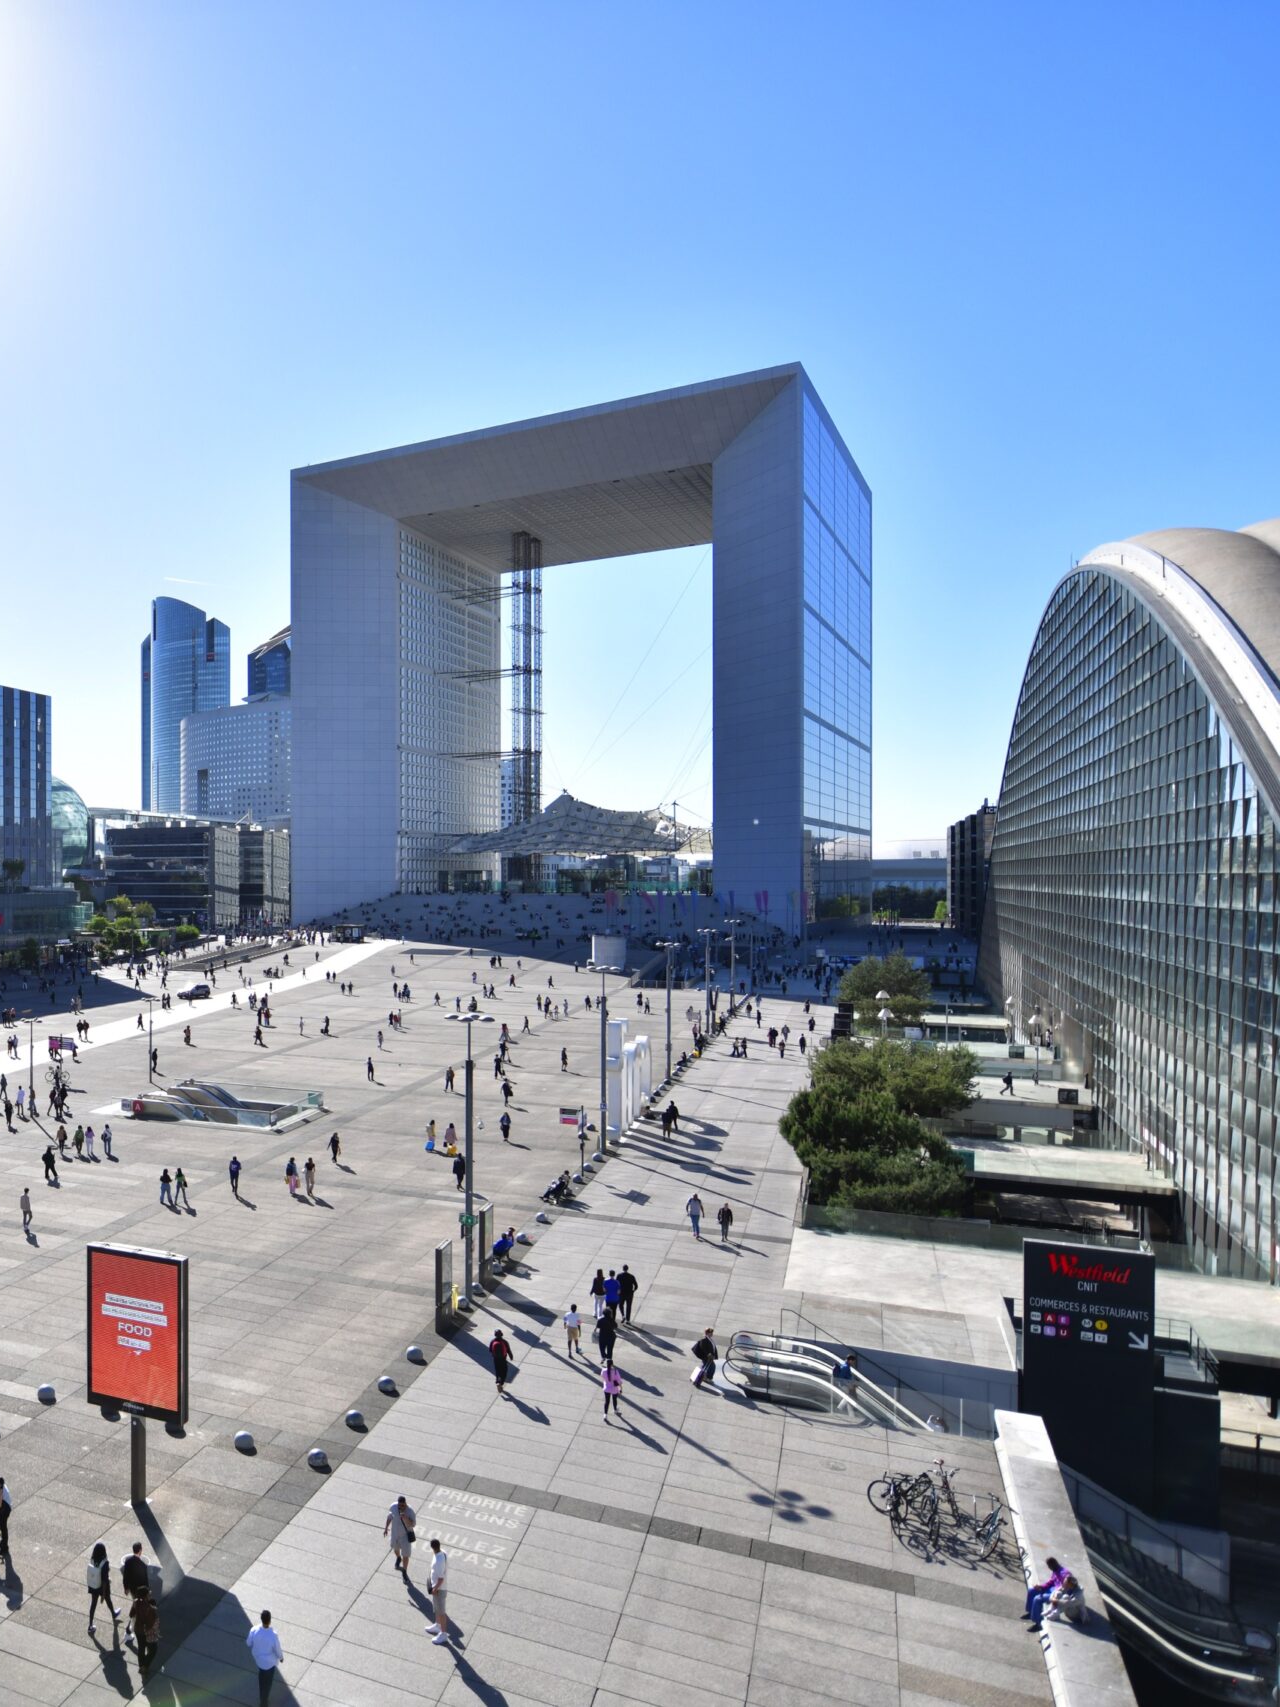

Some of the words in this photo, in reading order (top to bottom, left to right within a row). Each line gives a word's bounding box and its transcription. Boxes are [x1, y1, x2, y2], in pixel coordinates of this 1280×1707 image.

[1047, 1252, 1131, 1284] Westfield
[1077, 1281, 1099, 1292] CNIT
[1029, 1296, 1080, 1312] COMMERCES
[1081, 1303, 1088, 1313] &
[1089, 1304, 1149, 1321] RESTAURANTS
[118, 1322, 152, 1337] FOOD
[448, 1549, 499, 1569] PAS
